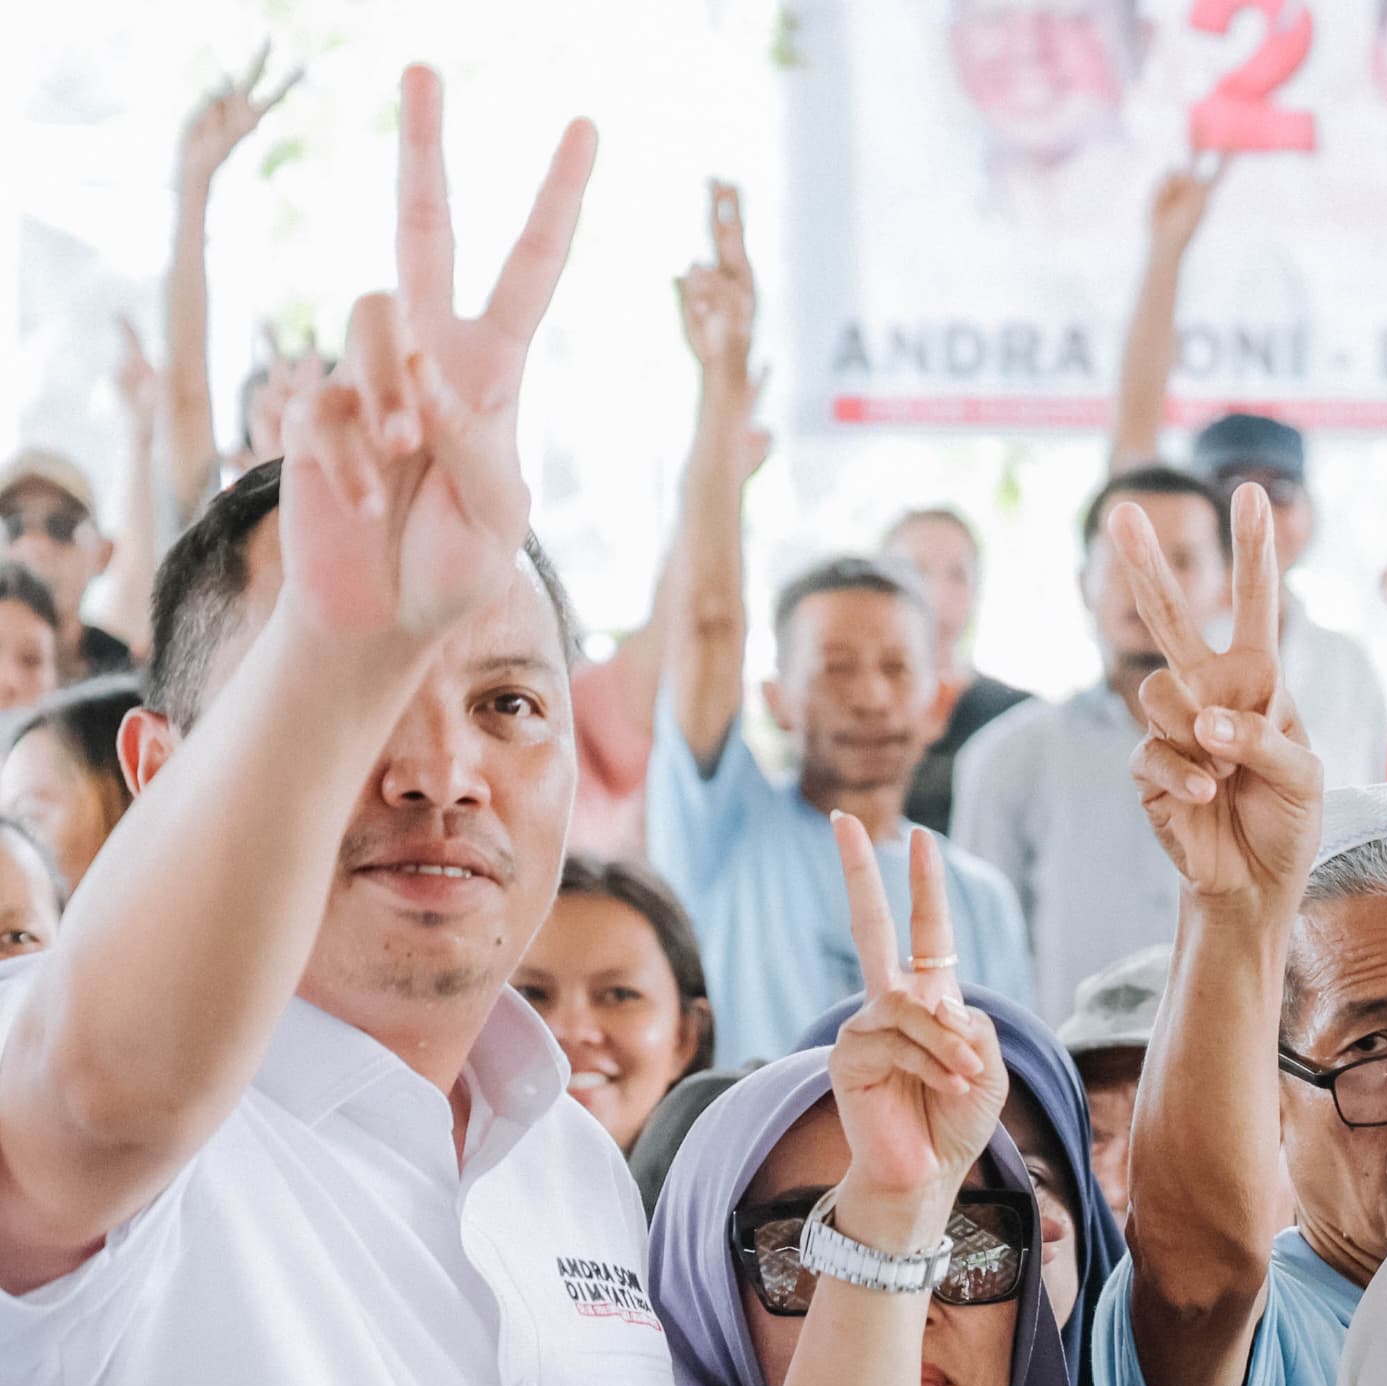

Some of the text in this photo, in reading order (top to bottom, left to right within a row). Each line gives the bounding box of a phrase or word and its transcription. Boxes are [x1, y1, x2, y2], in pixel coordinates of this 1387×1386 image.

[1190, 0, 1317, 153] 2
[832, 322, 1097, 377] ANDRA
[1176, 320, 1310, 377] ONI
[556, 1256, 615, 1283] ANDRA
